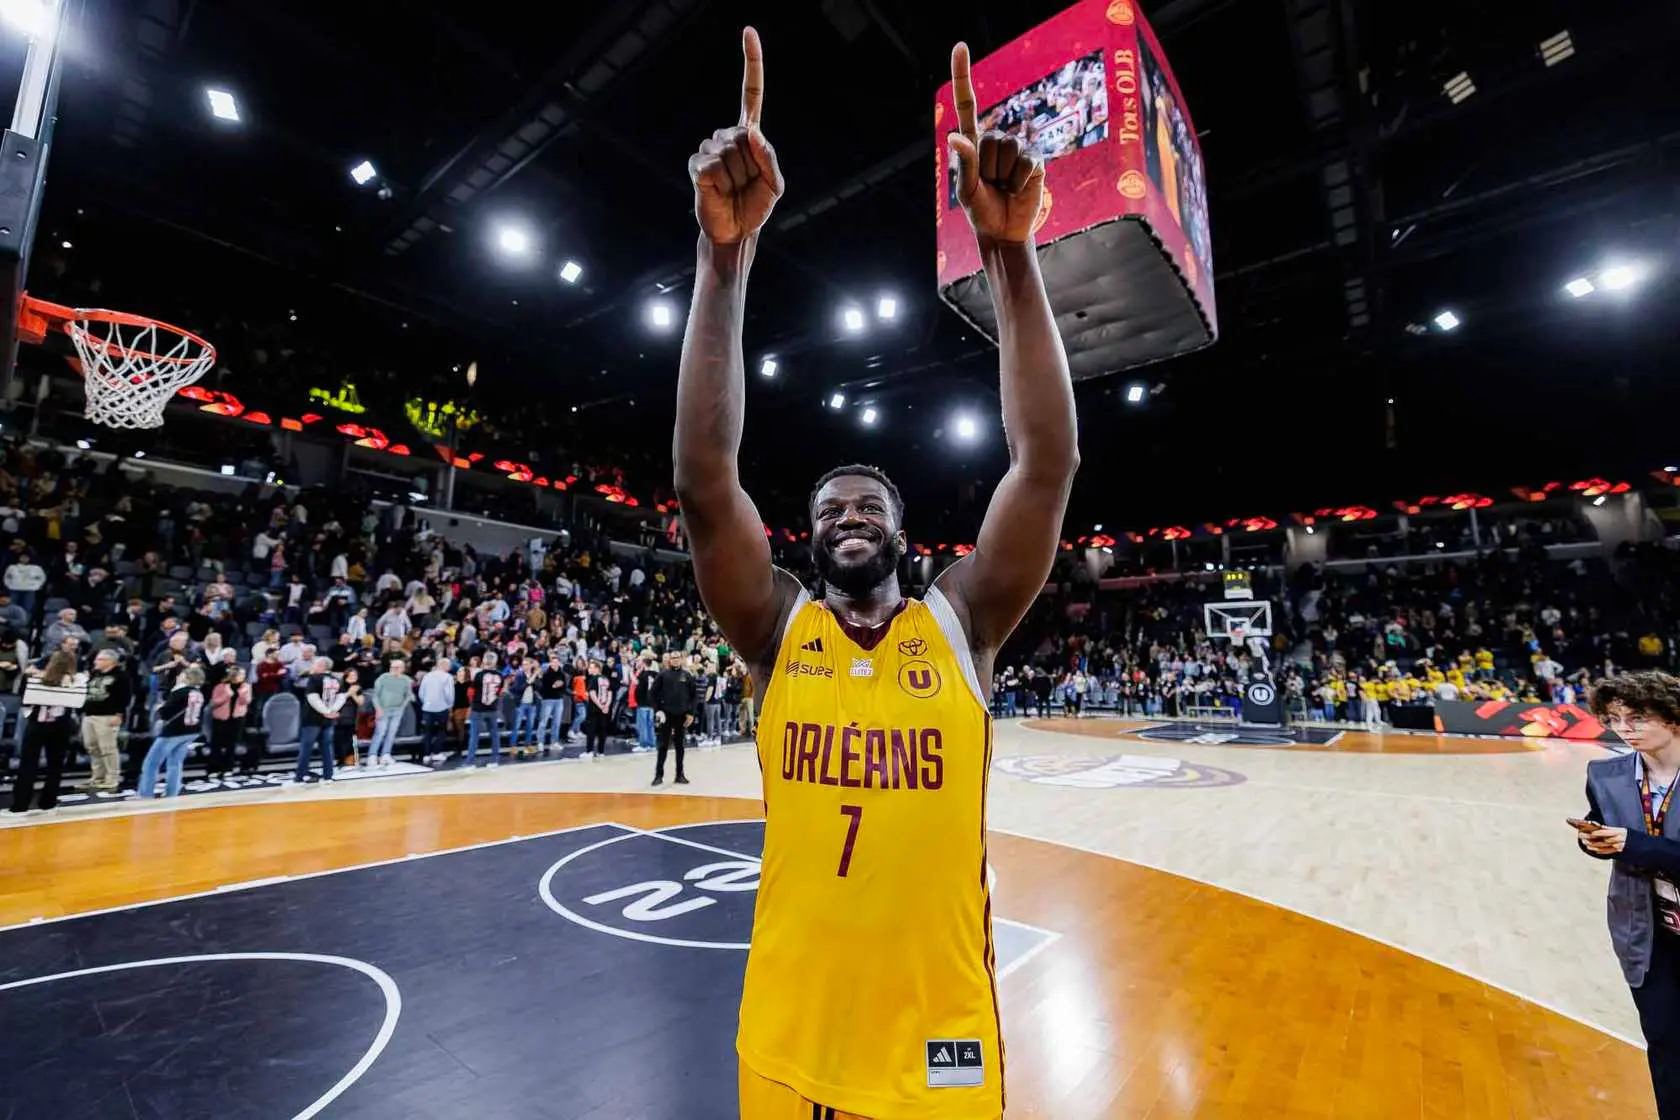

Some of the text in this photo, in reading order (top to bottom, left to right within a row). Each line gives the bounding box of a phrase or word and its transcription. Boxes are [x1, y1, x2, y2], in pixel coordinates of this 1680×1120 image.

[1115, 49, 1136, 93] OLB
[782, 721, 943, 790] ORLÉANS
[837, 804, 863, 878] 7
